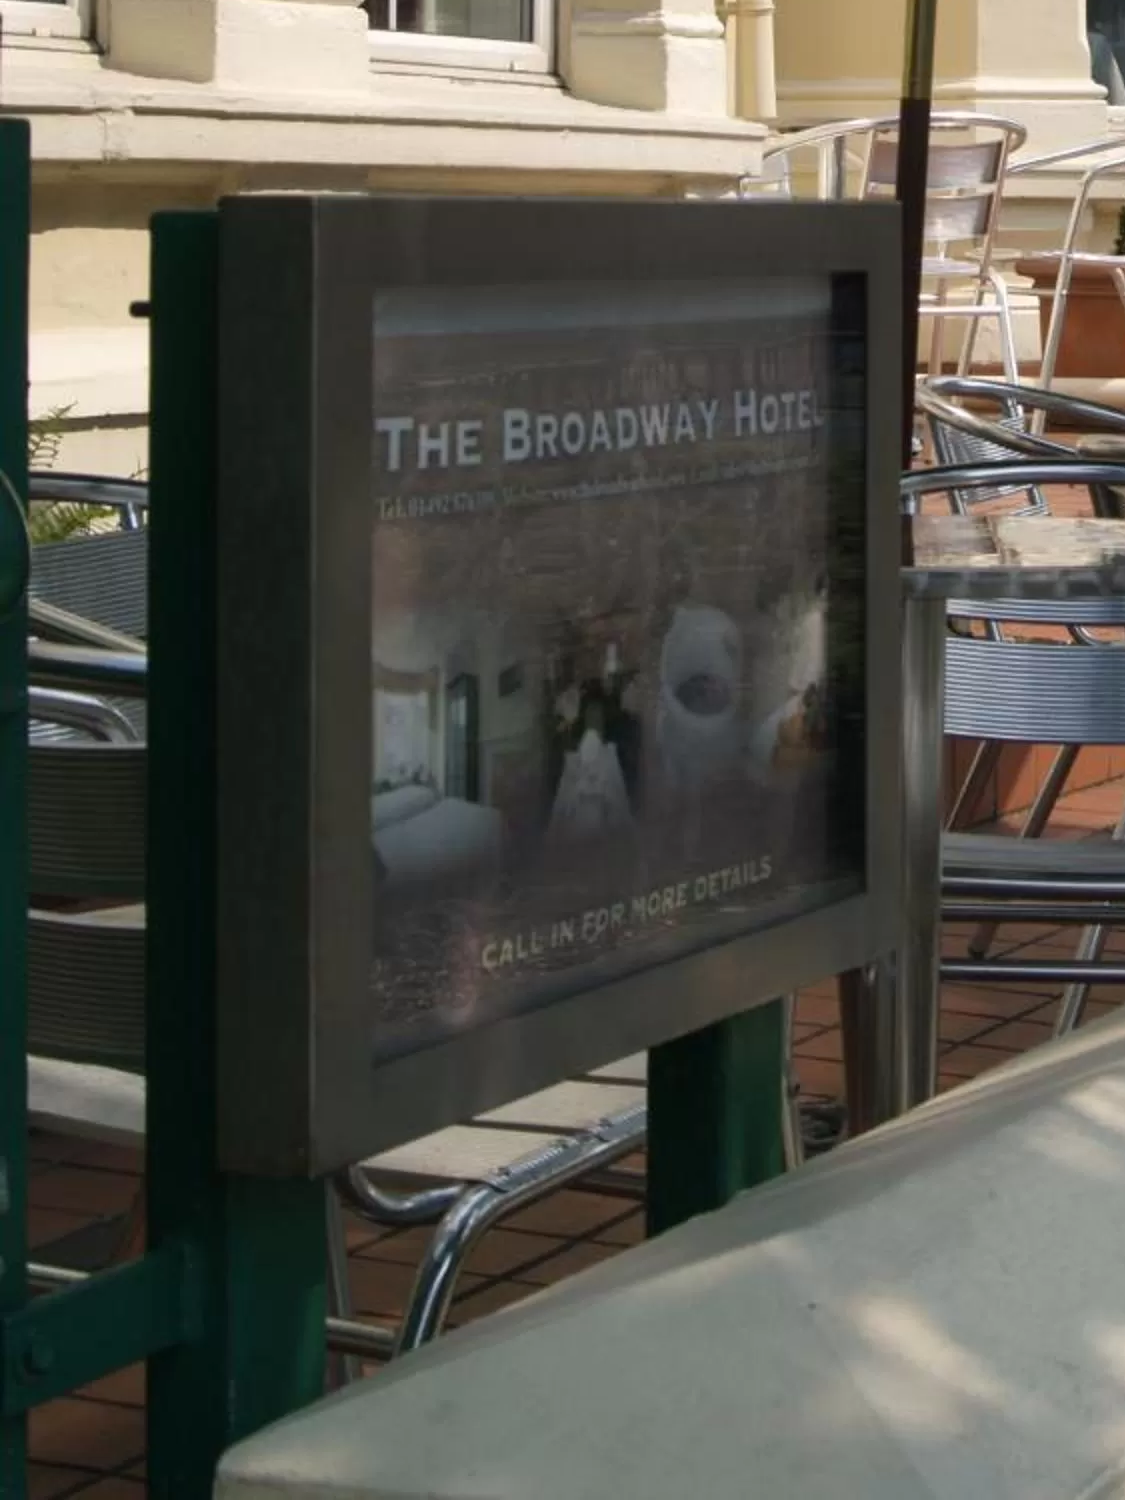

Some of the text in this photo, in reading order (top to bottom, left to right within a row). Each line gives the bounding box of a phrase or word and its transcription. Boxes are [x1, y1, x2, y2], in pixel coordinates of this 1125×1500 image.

[375, 416, 483, 471] THE
[503, 398, 720, 461] BROADWAY
[481, 855, 772, 969] CALL IN FOR MORE DETAILS
